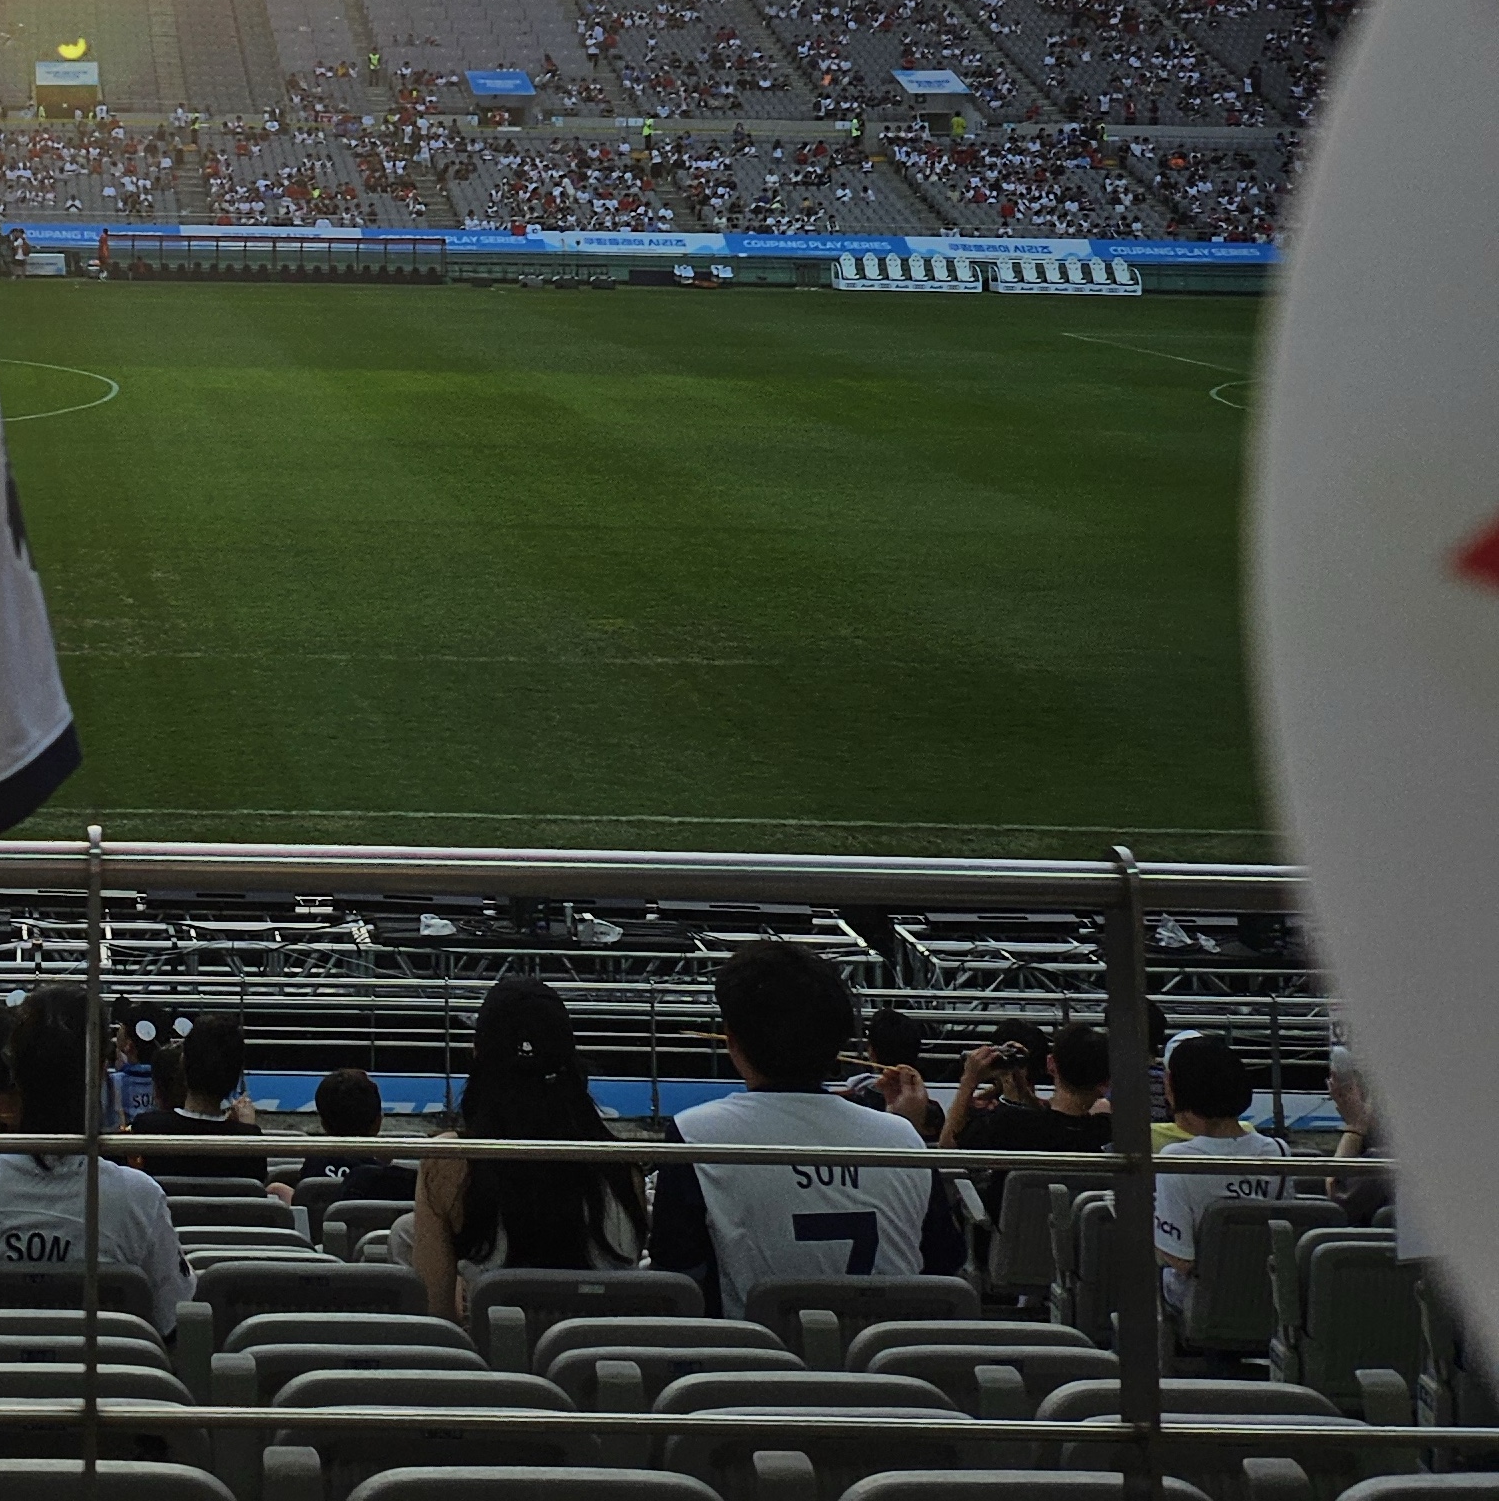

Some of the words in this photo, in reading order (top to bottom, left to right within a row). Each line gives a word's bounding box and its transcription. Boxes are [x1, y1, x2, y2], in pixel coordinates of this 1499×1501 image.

[24, 230, 82, 240] OUPANG
[446, 235, 478, 244] PLAY
[480, 236, 526, 244] SERIES
[743, 239, 807, 250] COUPANG
[808, 239, 841, 250] PLAY
[843, 239, 891, 250] SERIES
[1014, 243, 1053, 254] 시리즈
[1109, 246, 1175, 257] COUPANG
[1177, 246, 1209, 257] PLAY
[1211, 246, 1260, 257] SERIES
[792, 1165, 859, 1189] SON
[1227, 1179, 1269, 1199] SON
[5, 1232, 71, 1262] SON
